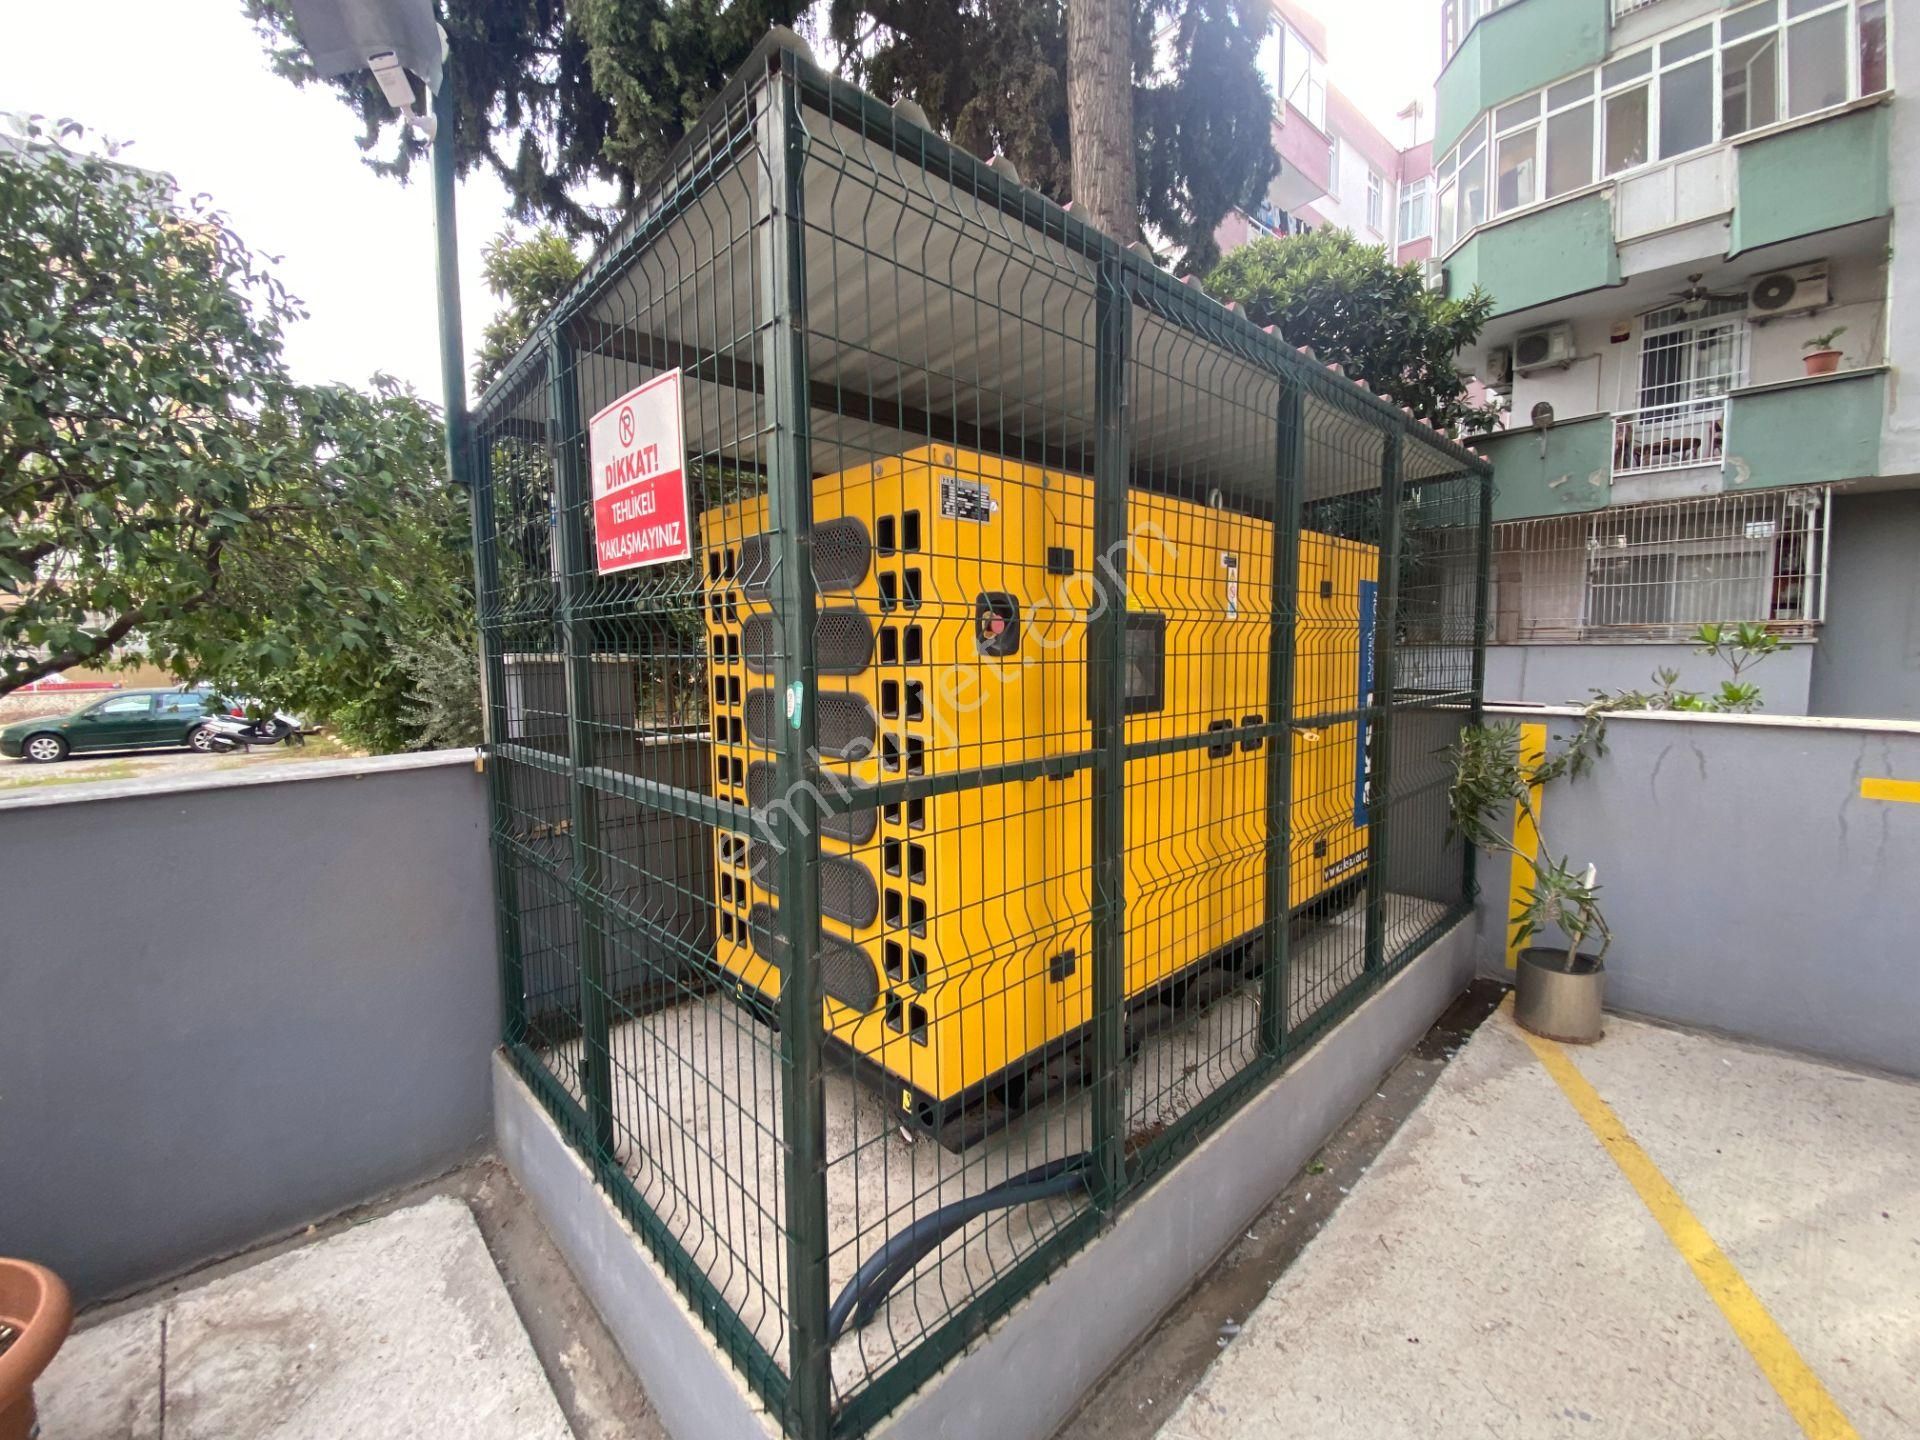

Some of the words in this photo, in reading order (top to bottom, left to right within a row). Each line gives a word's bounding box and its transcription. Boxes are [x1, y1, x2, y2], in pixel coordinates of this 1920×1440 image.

[605, 443, 659, 491] DİKKAT!
[611, 482, 656, 525] TEHLİKELİ
[600, 521, 682, 561] YAKLAŞMAYINIZ
